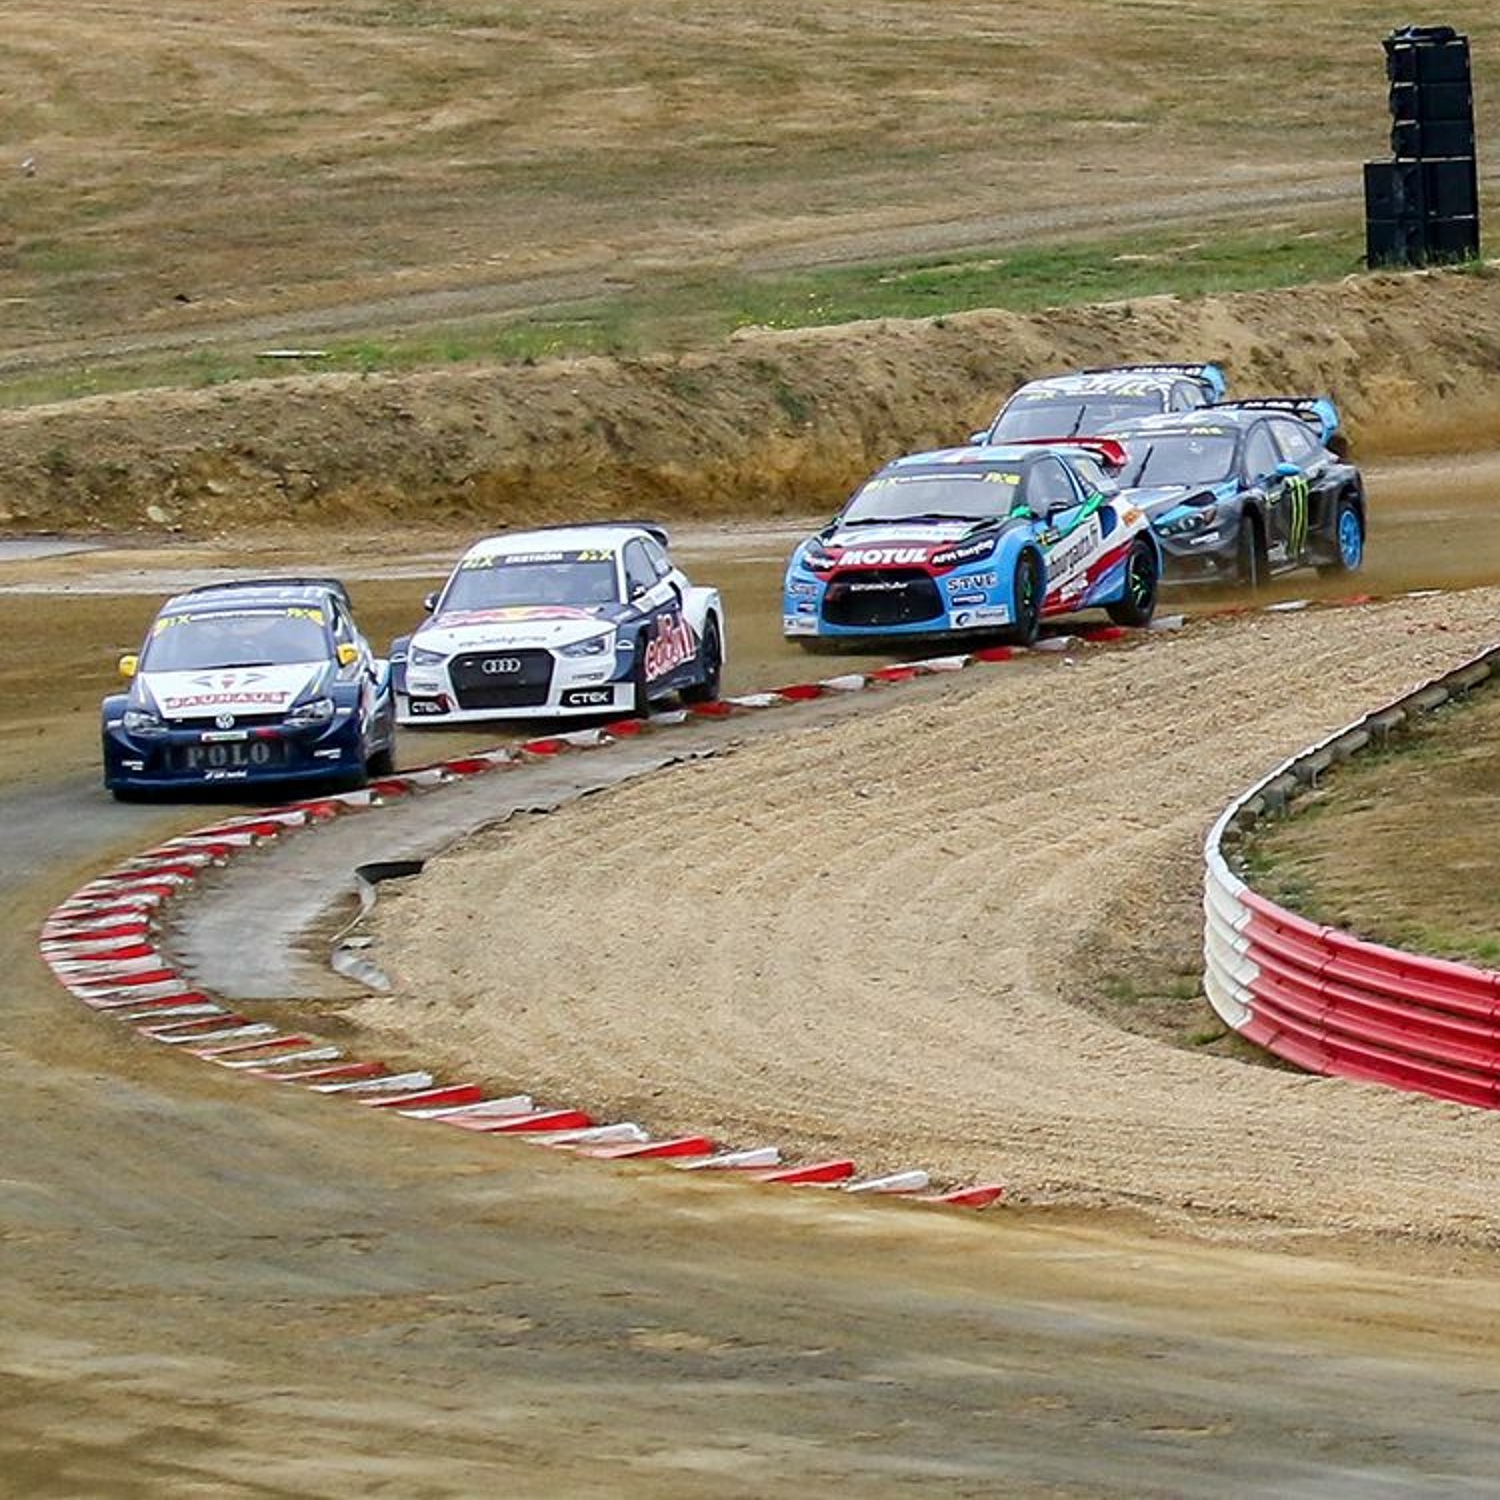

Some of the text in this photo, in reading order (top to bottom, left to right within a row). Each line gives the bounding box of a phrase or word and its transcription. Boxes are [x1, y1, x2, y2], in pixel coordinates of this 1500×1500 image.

[838, 548, 928, 566] MOTUL
[166, 692, 284, 710] BAUHAUS
[568, 692, 610, 706] CTEK
[187, 741, 271, 768] POLO
